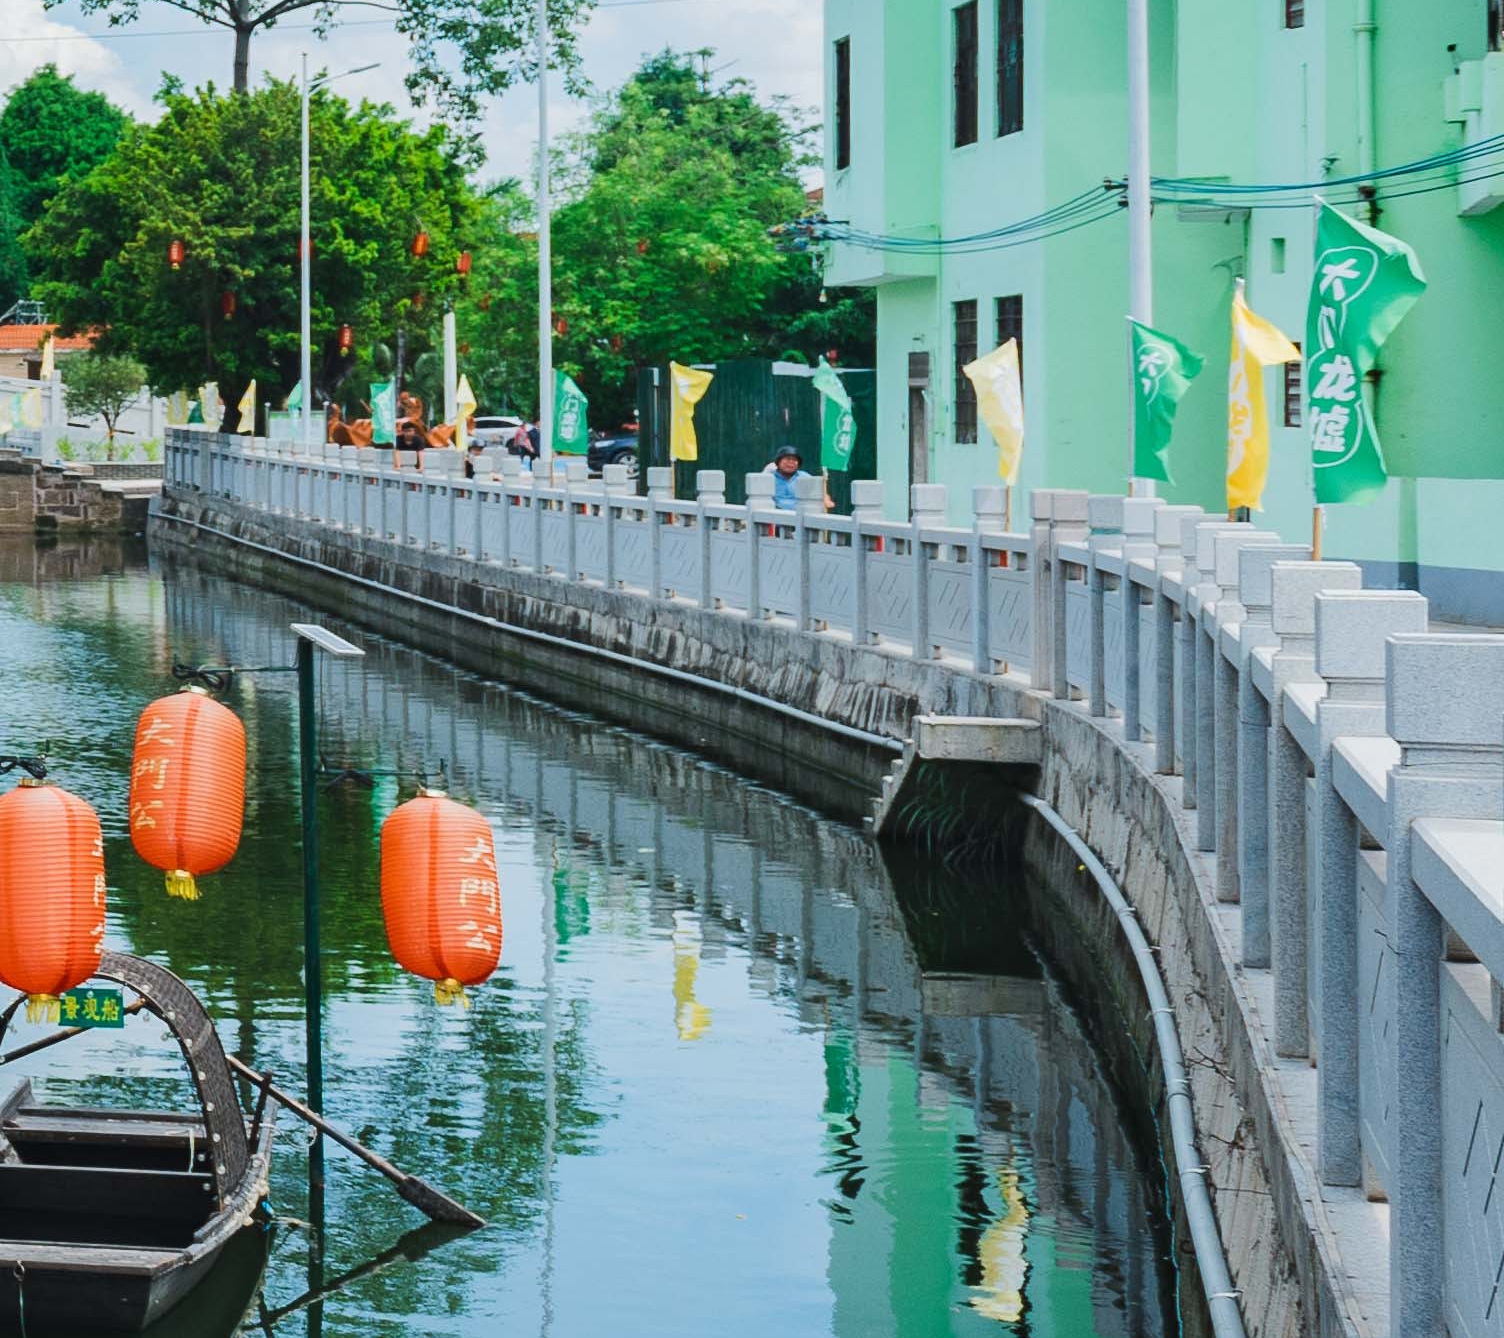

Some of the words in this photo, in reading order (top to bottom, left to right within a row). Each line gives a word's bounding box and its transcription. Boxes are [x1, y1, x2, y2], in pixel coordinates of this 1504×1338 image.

[456, 836, 498, 954] 大門公
[63, 995, 119, 1021] 景观船
